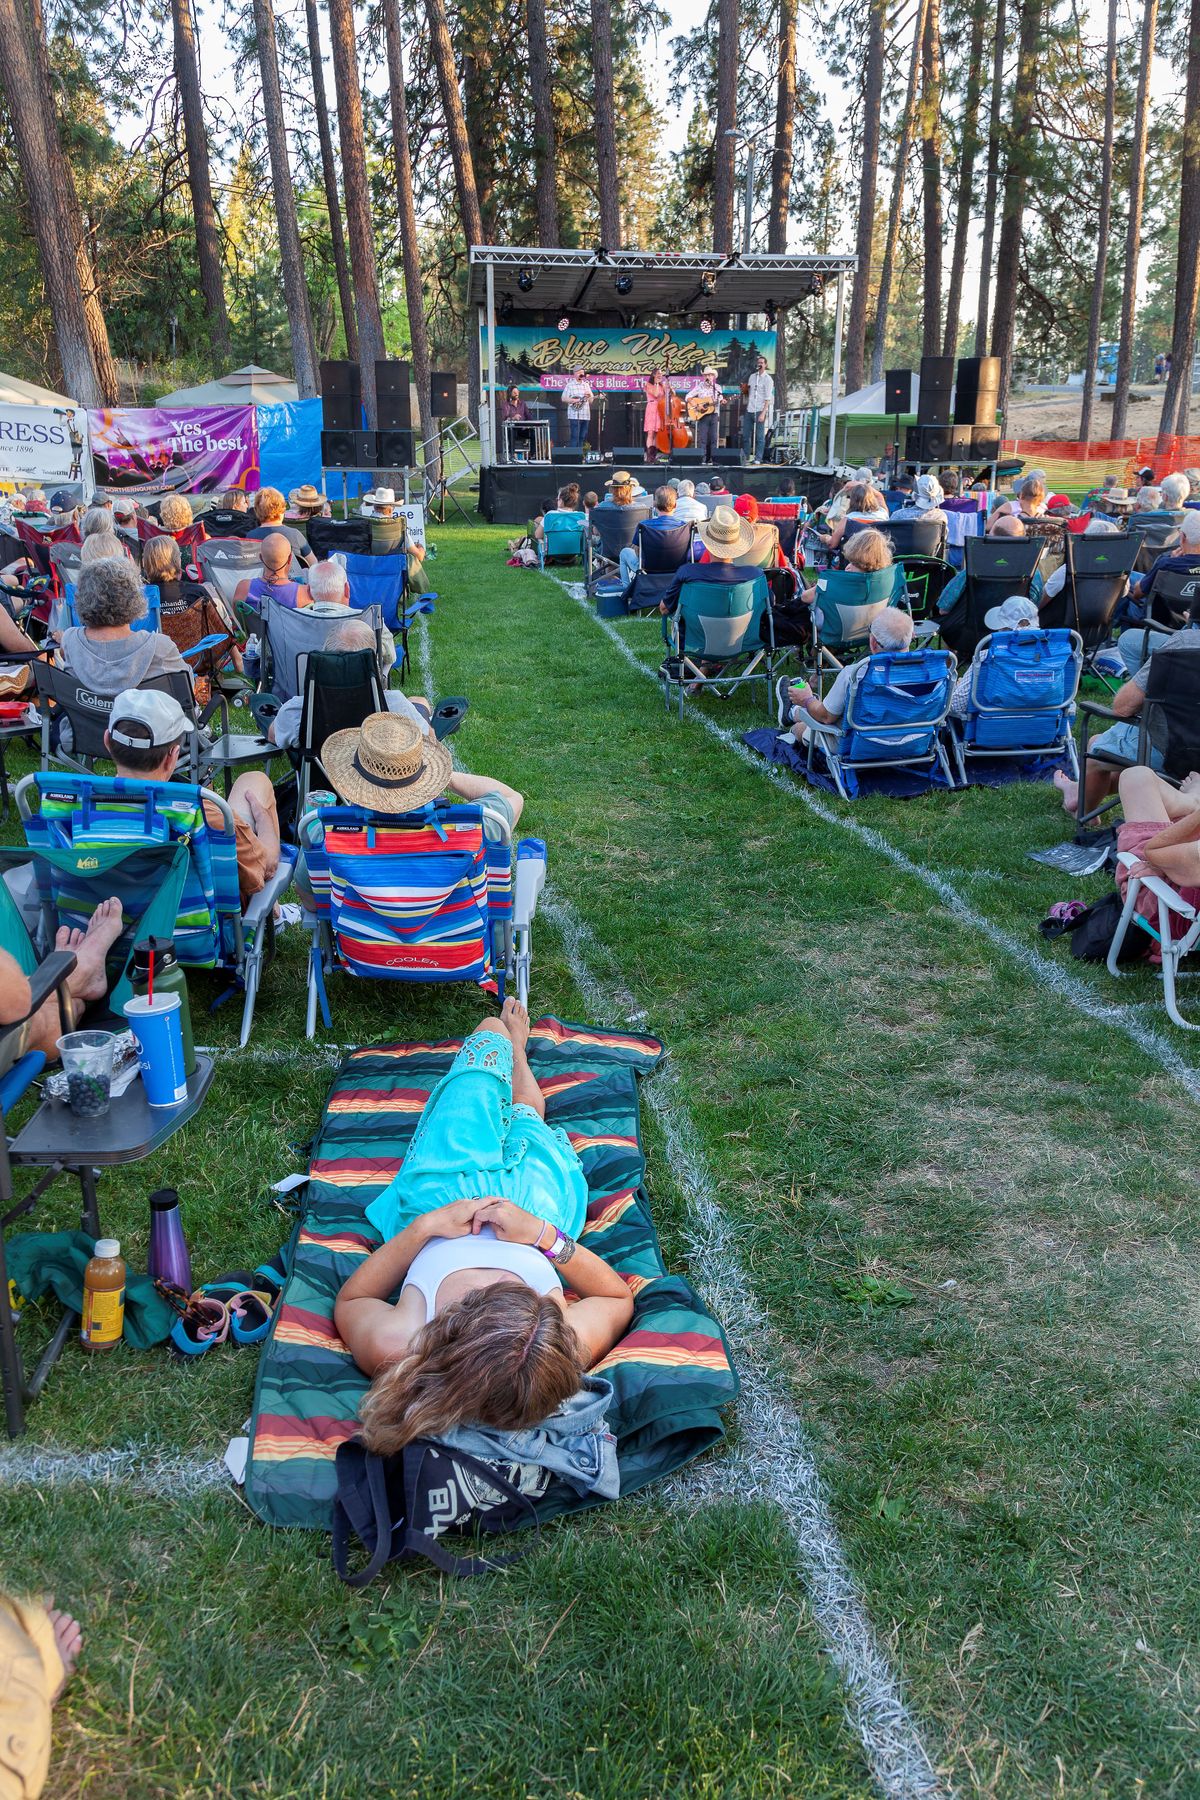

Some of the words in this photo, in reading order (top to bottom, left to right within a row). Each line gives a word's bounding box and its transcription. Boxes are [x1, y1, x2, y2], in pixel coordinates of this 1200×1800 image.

[532, 334, 609, 368] Blue
[566, 359, 633, 374] Bluegrass
[638, 359, 691, 372] Festval
[544, 377, 563, 388] The
[596, 377, 604, 388] is
[606, 377, 630, 388] Blue.
[634, 378, 647, 389] Th
[168, 420, 207, 437] Yes.
[16, 445, 34, 454] 1896
[167, 436, 204, 453] The
[206, 435, 248, 452] best.
[104, 484, 176, 493] NORTHERNQUEST.COM
[392, 510, 415, 520] ase
[80, 692, 114, 709] Colem
[385, 955, 440, 968] COOLER
